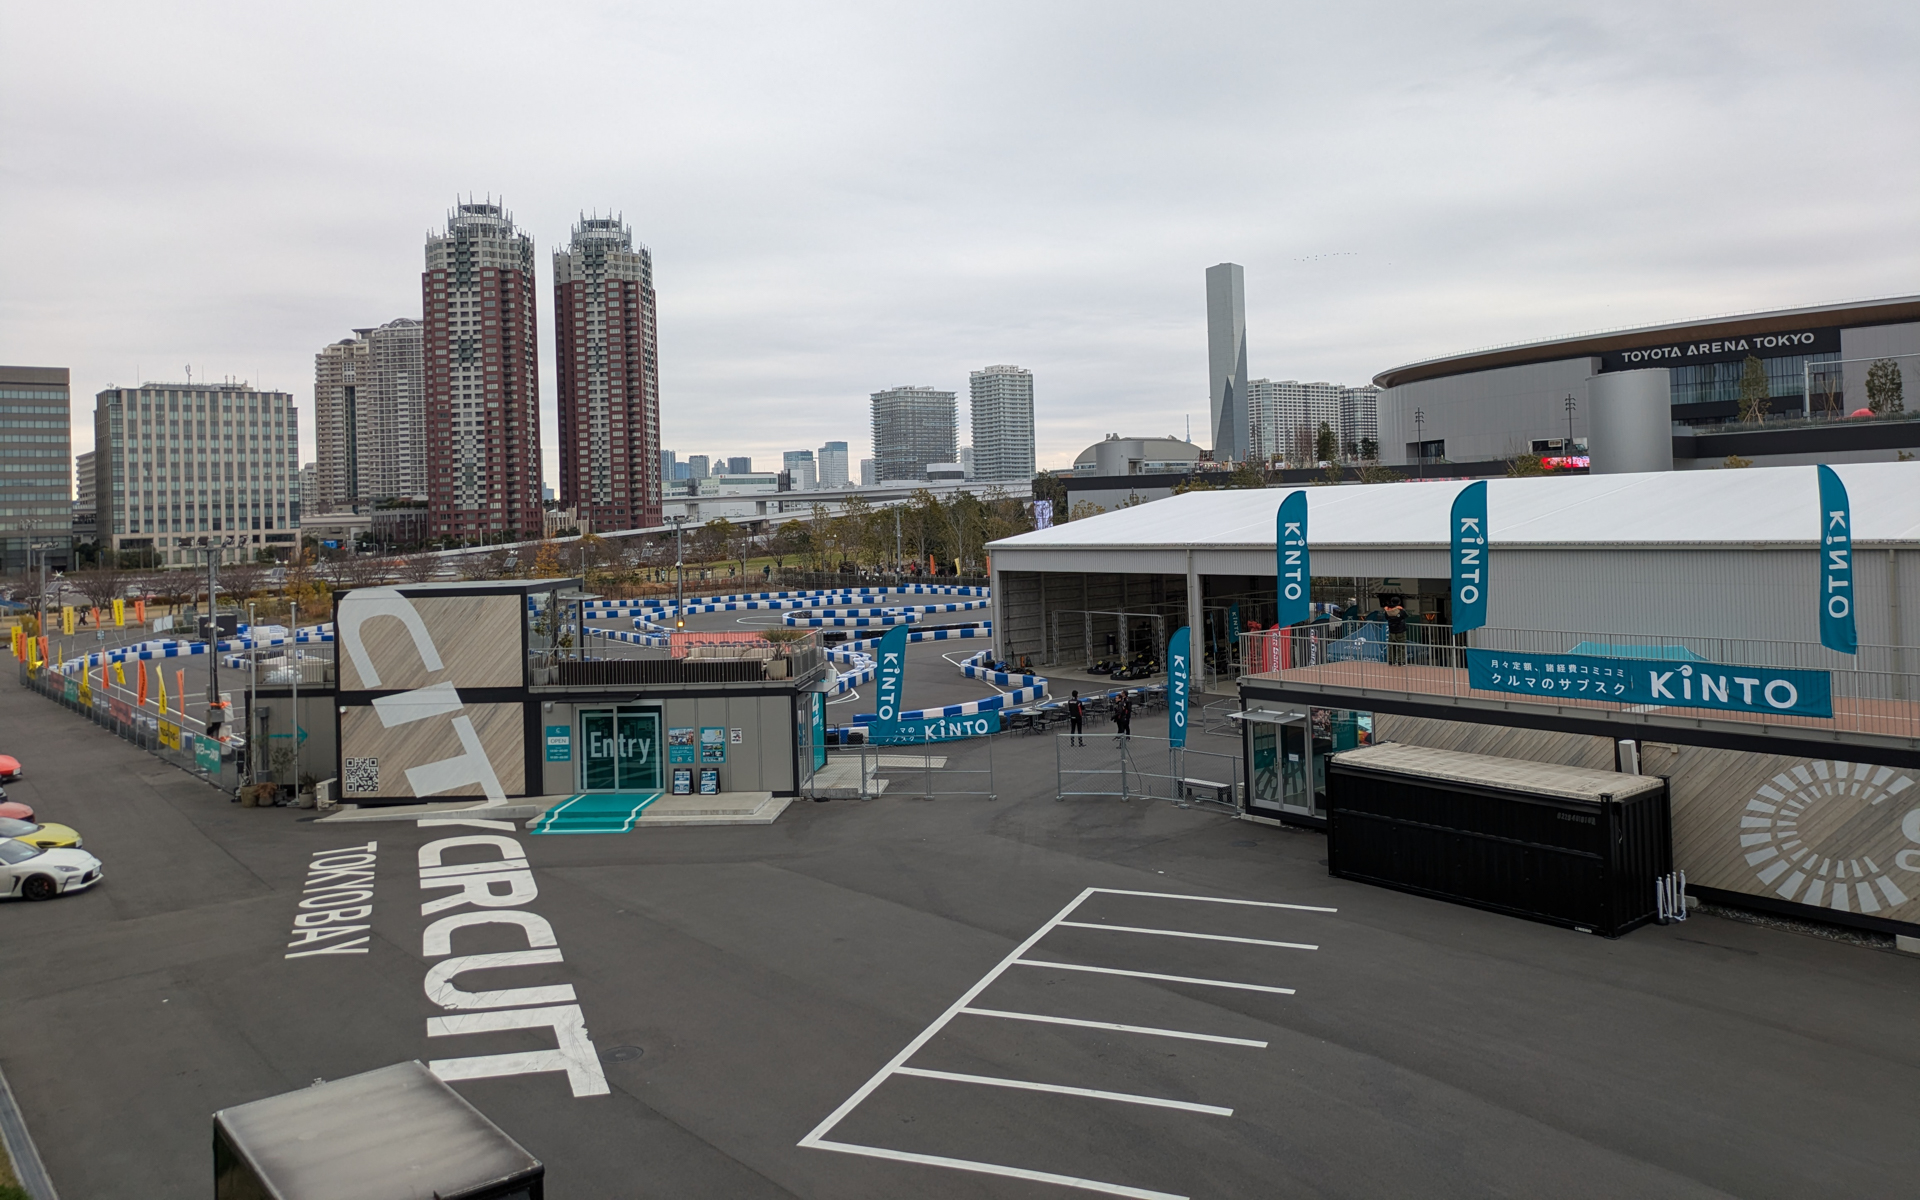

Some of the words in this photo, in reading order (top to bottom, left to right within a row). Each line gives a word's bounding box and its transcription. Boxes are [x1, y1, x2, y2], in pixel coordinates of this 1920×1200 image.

[1622, 347, 1682, 363] TOYOTA
[1686, 339, 1749, 356] ARENA
[1753, 332, 1815, 349] TOKYO
[1491, 659, 1624, 678] 月々定額、諸経費コミコミ
[1491, 673, 1626, 696] クルマのサブスク
[590, 731, 651, 764] Entry
[418, 834, 611, 1098] CIRCUIT
